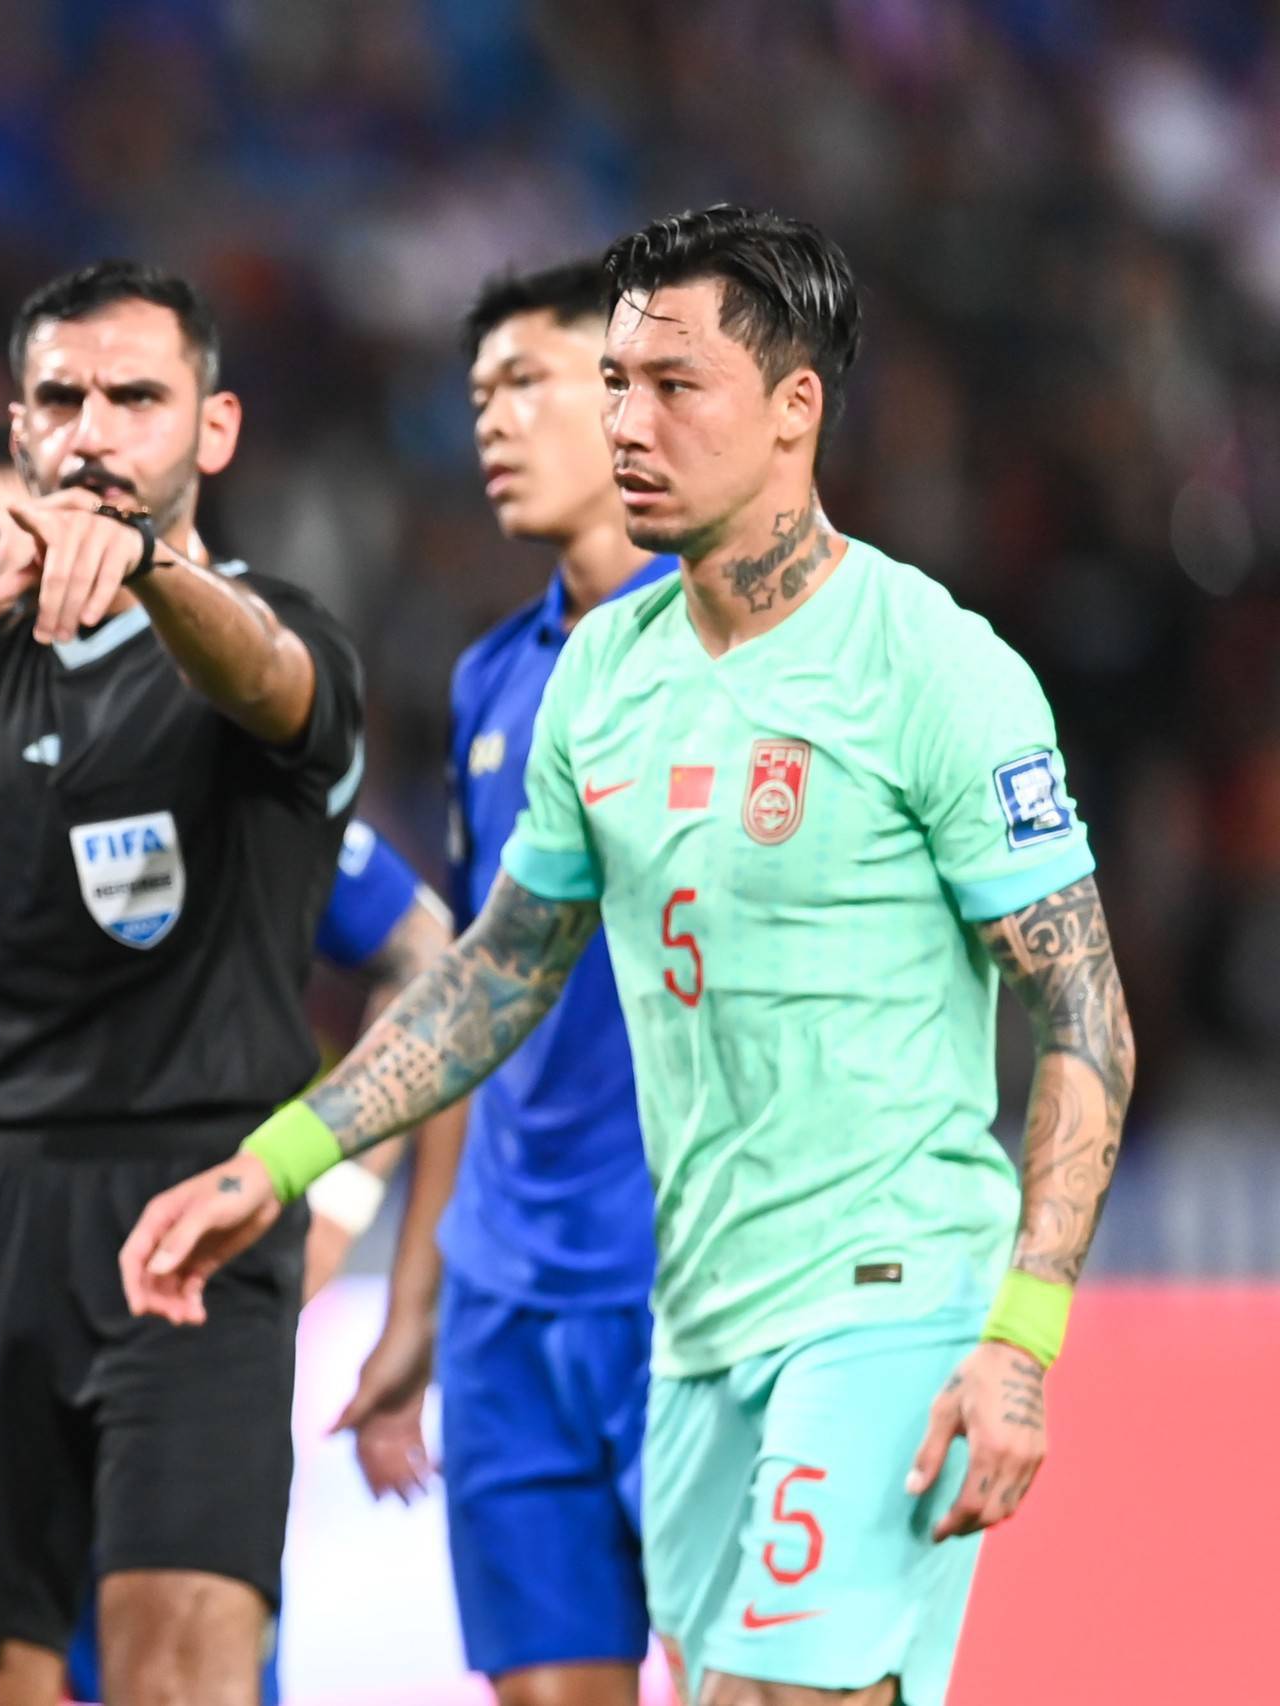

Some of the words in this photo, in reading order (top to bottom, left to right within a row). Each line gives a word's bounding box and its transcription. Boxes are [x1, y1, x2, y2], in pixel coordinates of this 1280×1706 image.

[85, 828, 167, 862] FIFA
[662, 888, 703, 1008] 5
[762, 1465, 827, 1585] 5
